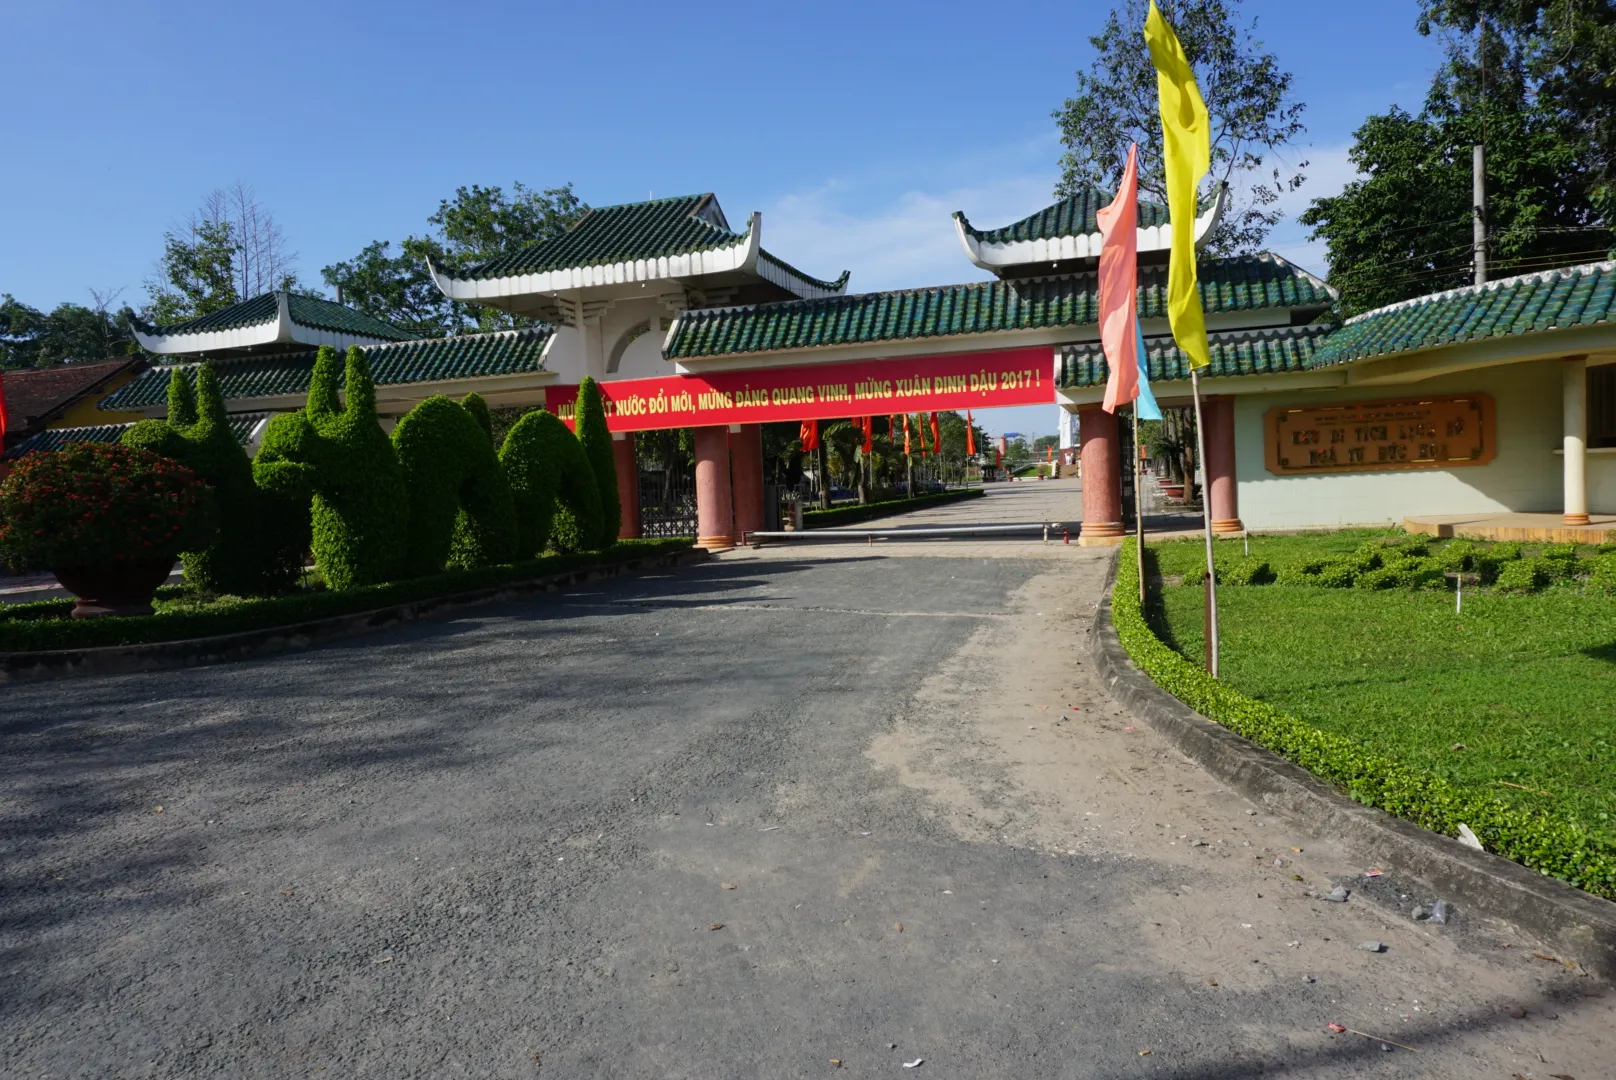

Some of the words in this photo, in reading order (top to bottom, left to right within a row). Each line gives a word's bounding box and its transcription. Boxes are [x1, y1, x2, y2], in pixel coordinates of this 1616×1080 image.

[615, 394, 646, 416] NƯỚC
[648, 388, 669, 414] ĐỔI
[671, 390, 696, 414] MỚI,
[698, 388, 733, 410] MỪNG
[736, 384, 769, 408] ĐẢNG
[772, 386, 815, 407] QUANG
[817, 383, 852, 404] VINH,
[855, 376, 892, 400] MỪNG
[895, 374, 931, 397] XUÂN
[934, 374, 967, 394] ĐINH
[970, 369, 997, 397] DẬU
[1001, 369, 1032, 390] 2017
